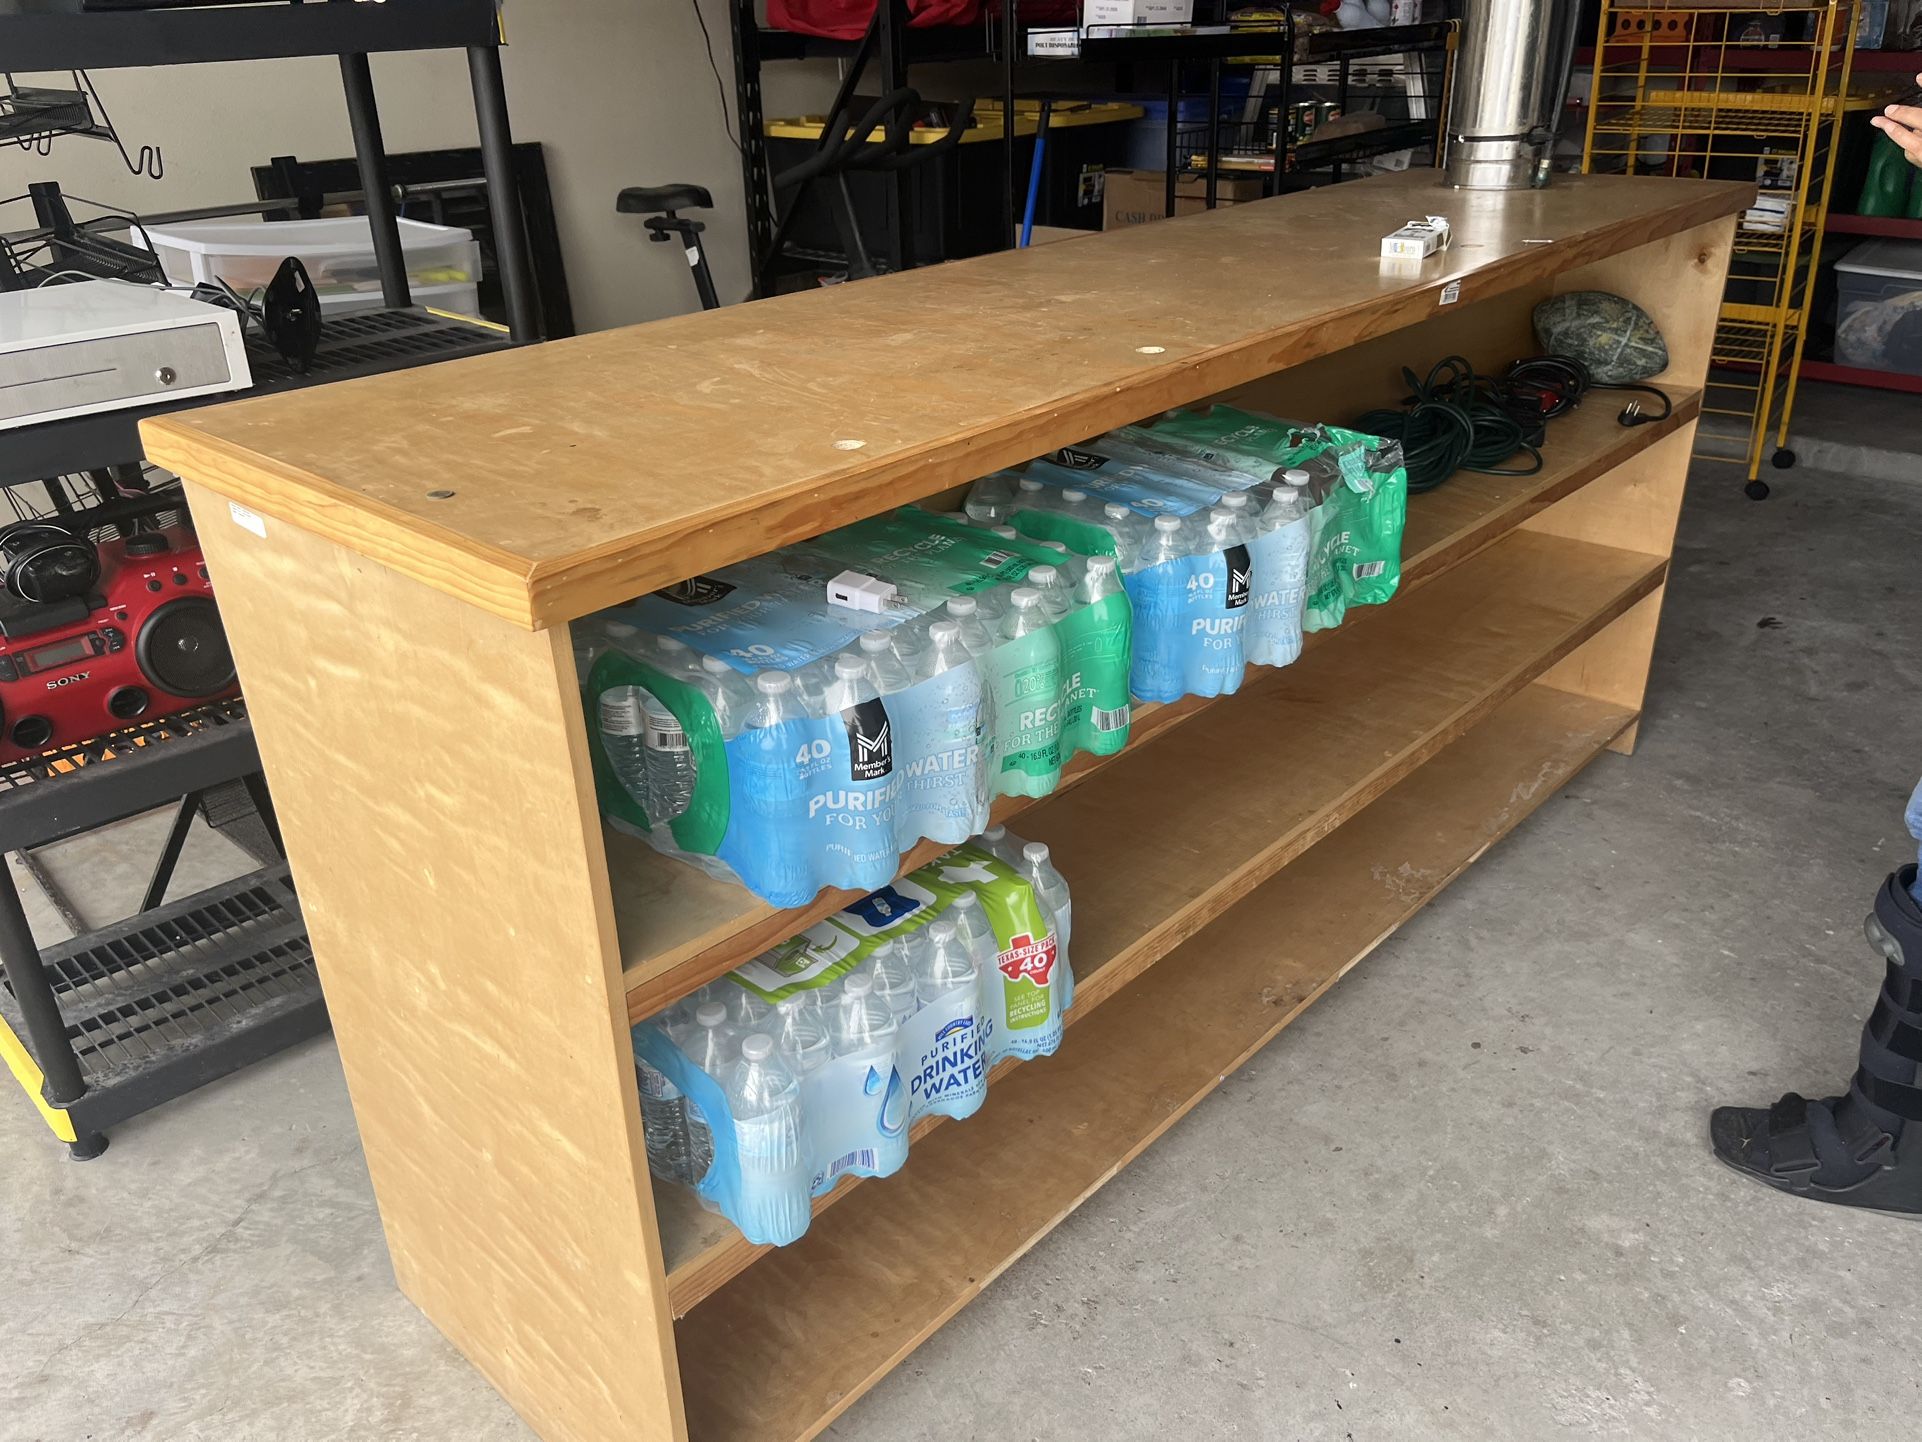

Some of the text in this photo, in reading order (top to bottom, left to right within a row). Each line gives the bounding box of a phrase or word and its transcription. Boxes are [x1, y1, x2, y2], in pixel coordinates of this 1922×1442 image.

[1187, 572, 1215, 592] 40
[730, 644, 775, 658] 40
[1203, 637, 1233, 651] FOR
[46, 671, 91, 691] SONY
[796, 739, 832, 766] 40
[1004, 733, 1031, 752] FOR
[854, 756, 892, 772] Member's
[906, 744, 979, 778] WATER
[865, 767, 886, 779] Mark
[825, 812, 868, 831] FOR
[907, 772, 965, 792] THIRST
[998, 936, 1056, 966] TEXAS-SIZE PACK
[1019, 952, 1048, 972] 40
[1009, 1000, 1046, 1018] RECYCLING
[1010, 1008, 1047, 1024] INSTRUCTIONS
[922, 1015, 985, 1067] PURIFIED
[911, 1018, 993, 1097] DRINKING
[924, 1050, 986, 1101] WATER
